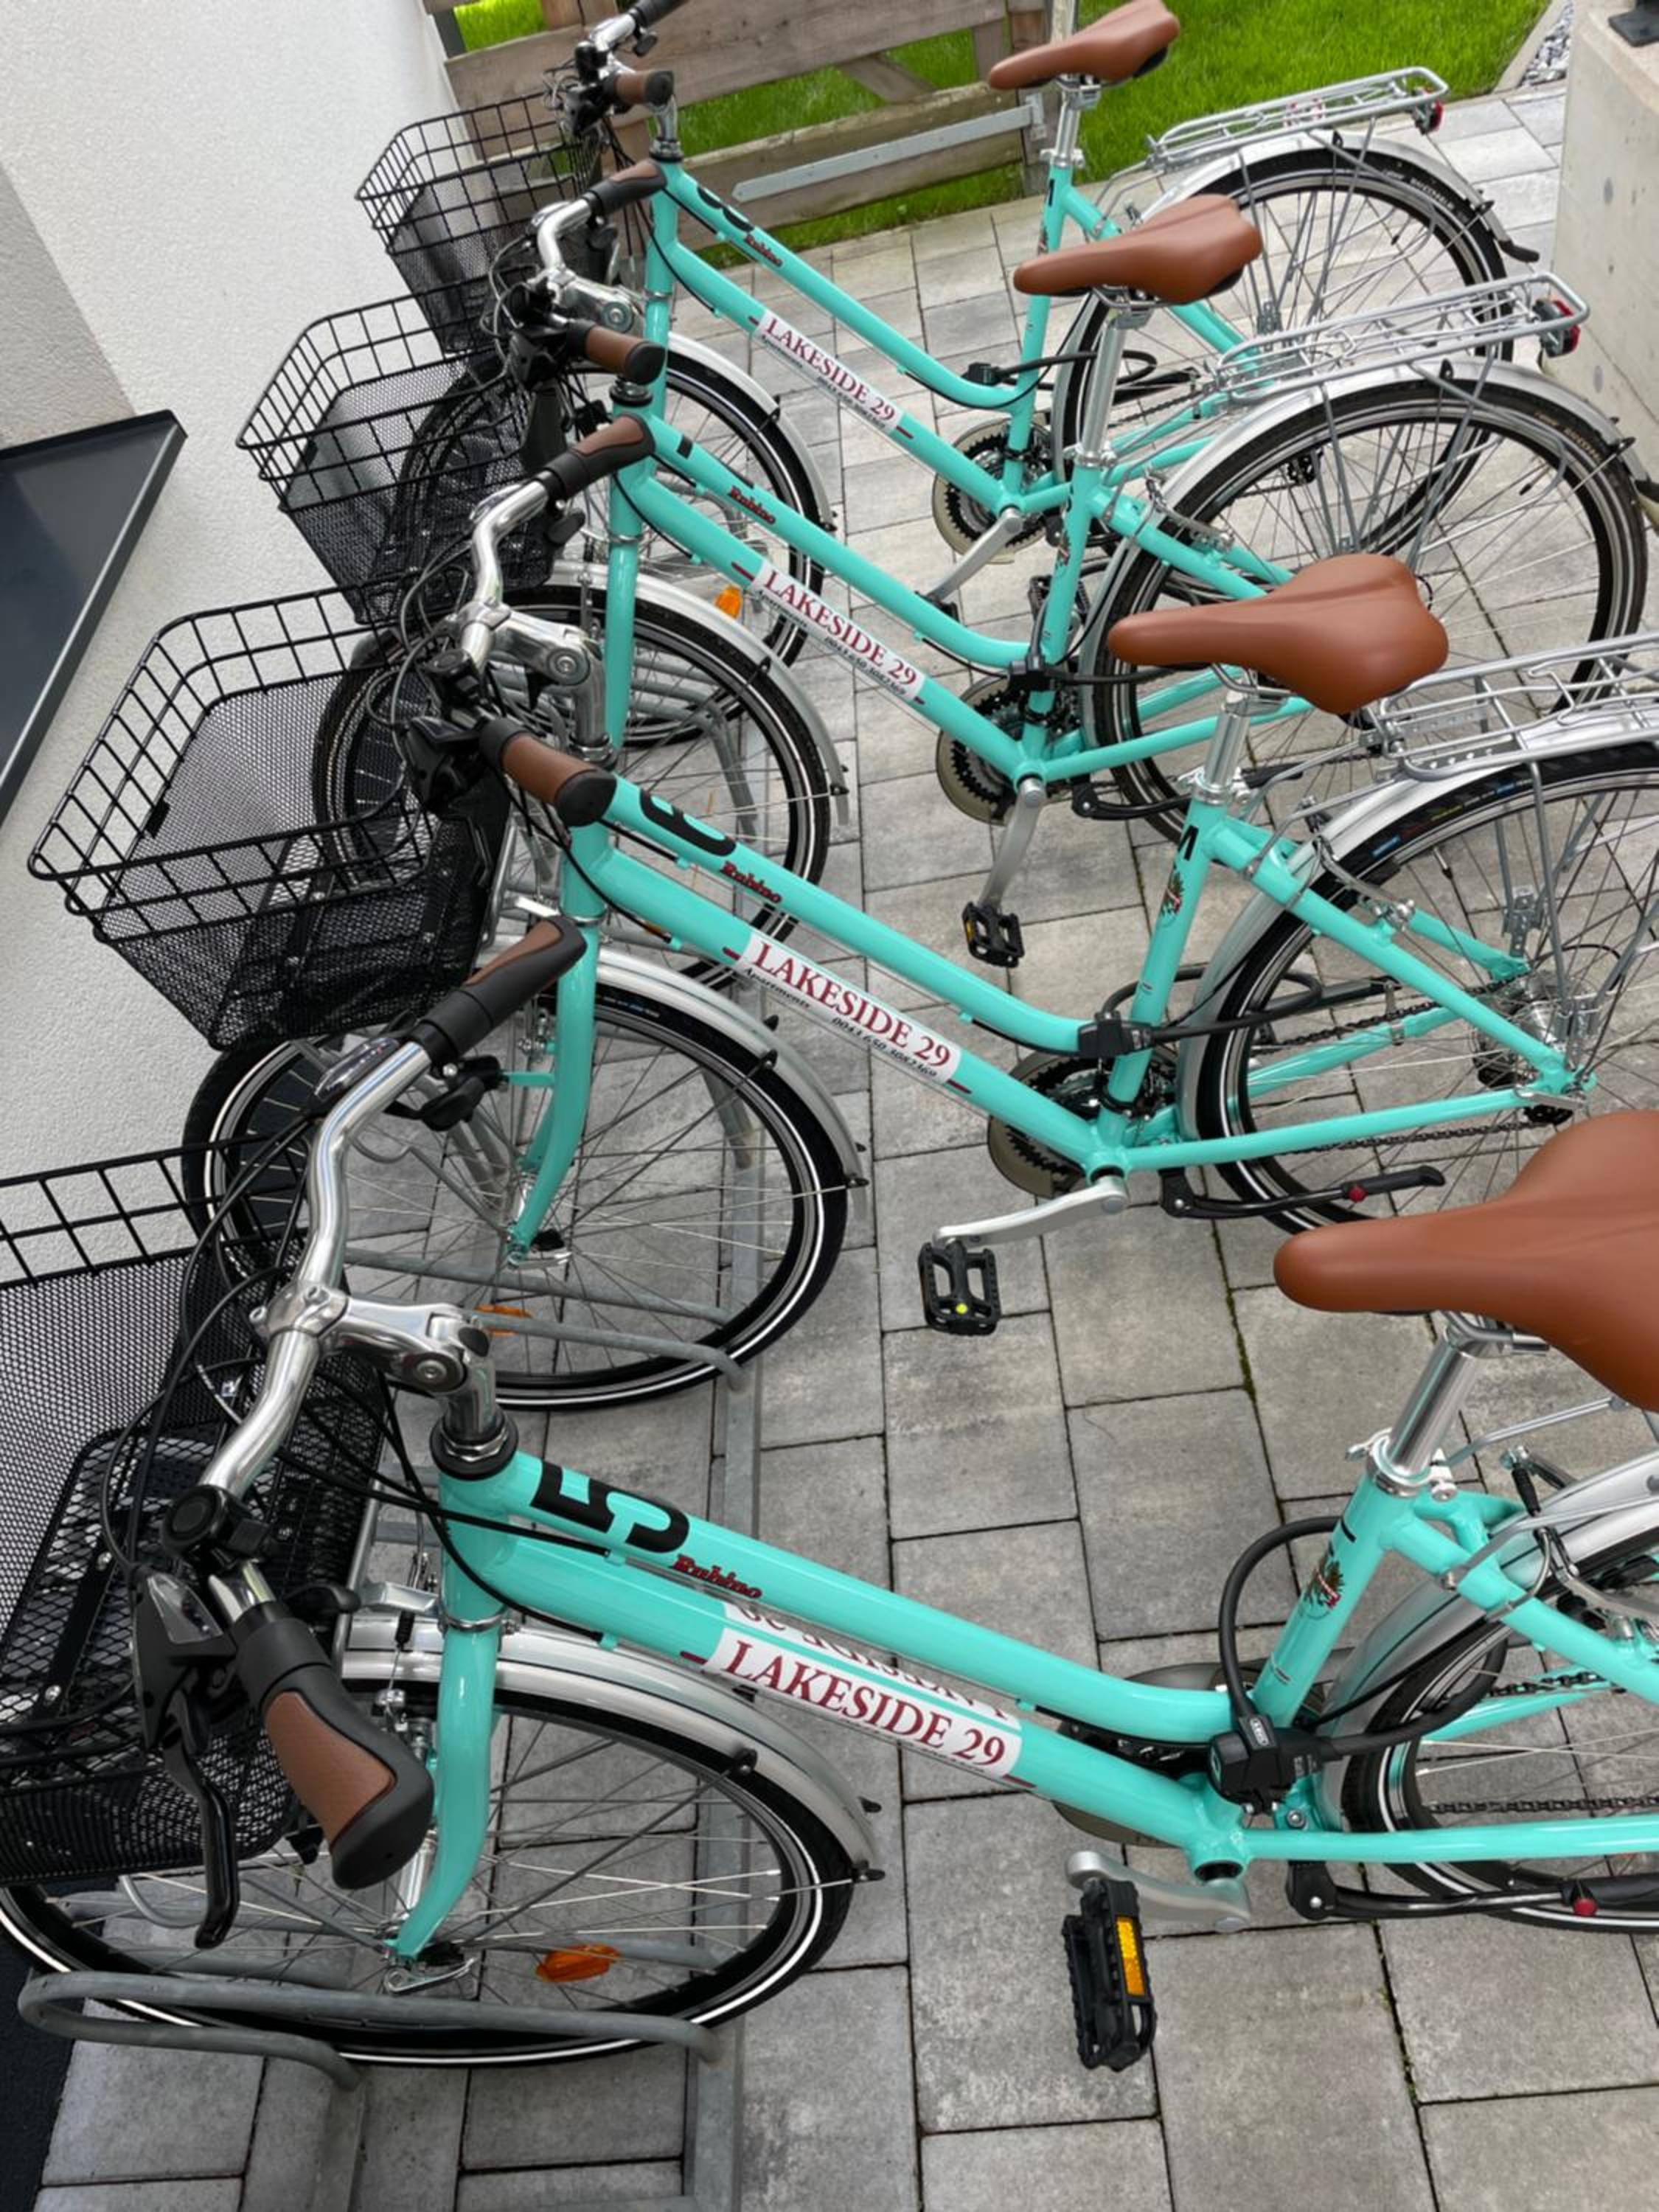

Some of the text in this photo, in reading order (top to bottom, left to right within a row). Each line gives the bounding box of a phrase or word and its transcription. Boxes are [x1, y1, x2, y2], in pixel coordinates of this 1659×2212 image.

[765, 317, 868, 406] LAKESIDE
[870, 394, 897, 421] 29
[764, 571, 917, 686] LAKESIDE 29
[744, 966, 810, 1009] Apartments
[751, 942, 951, 1068] LAKESIDE 29
[532, 1459, 689, 1553] 5
[669, 1554, 762, 1599] Rubino
[722, 1640, 951, 1748] LAKESIDE
[954, 1728, 1006, 1767] 29
